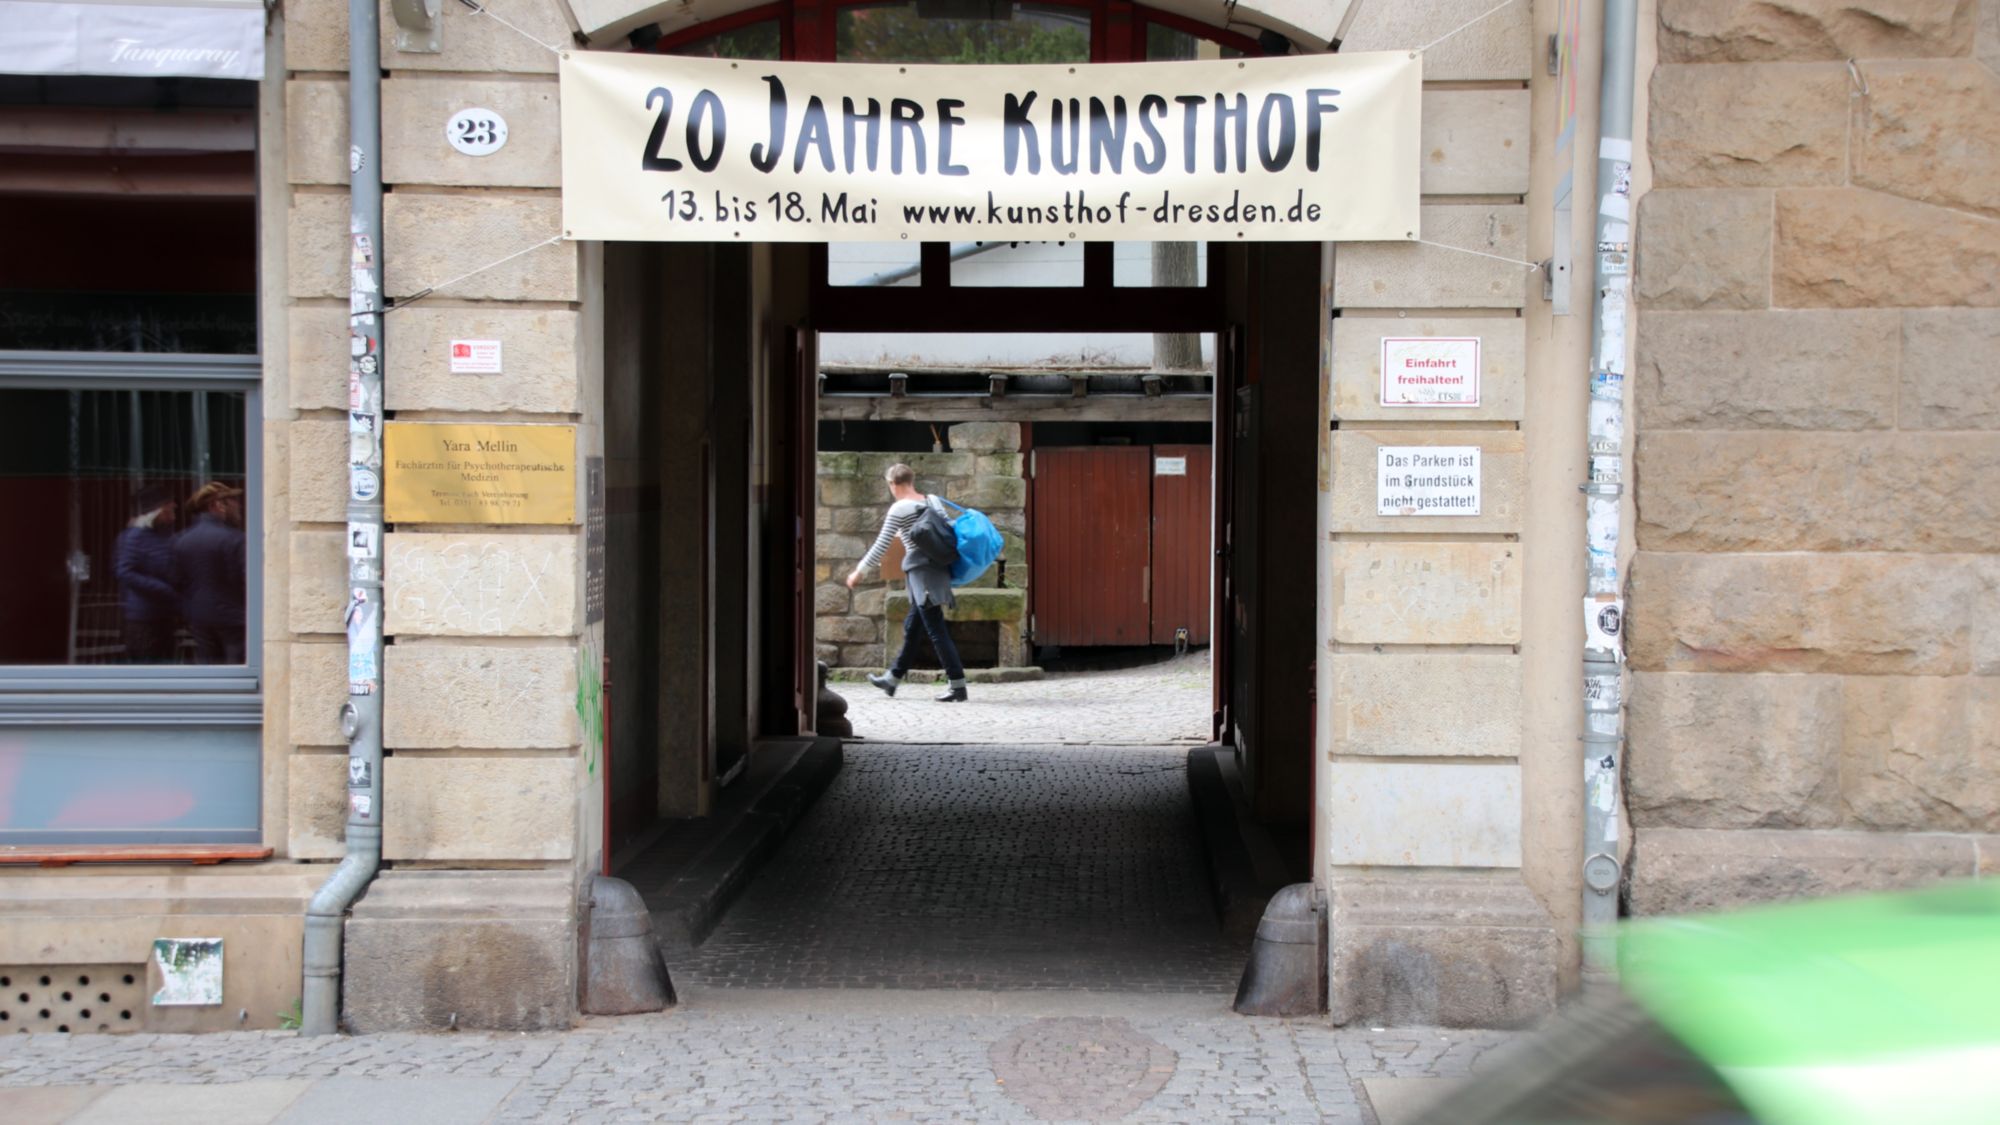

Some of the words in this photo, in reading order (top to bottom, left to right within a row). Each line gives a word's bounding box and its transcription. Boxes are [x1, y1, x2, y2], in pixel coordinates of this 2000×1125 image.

[111, 38, 240, 70] Tanqueray
[457, 119, 497, 145] 23
[642, 86, 727, 173] 20
[750, 75, 969, 176] JAHRE
[1003, 88, 1341, 175] KUNSTHOF
[661, 190, 704, 222] 13.
[716, 190, 757, 222] bis
[767, 191, 812, 223] 18.
[822, 192, 877, 223] Mai
[903, 189, 1321, 224] www.kunsthof-dresden.de
[1405, 358, 1457, 368] Einfahrt
[1397, 375, 1464, 385] freihalten!
[443, 439, 471, 452] Yara
[477, 440, 518, 453] Mellin
[1386, 454, 1409, 467] Das
[1412, 454, 1455, 467] Parken
[1458, 455, 1474, 467] ist
[461, 472, 499, 481] Medizin
[1385, 474, 1400, 487] im
[1404, 474, 1474, 487] Grundstück
[1383, 495, 1413, 507] nicht
[1417, 495, 1475, 510] gestattet!
